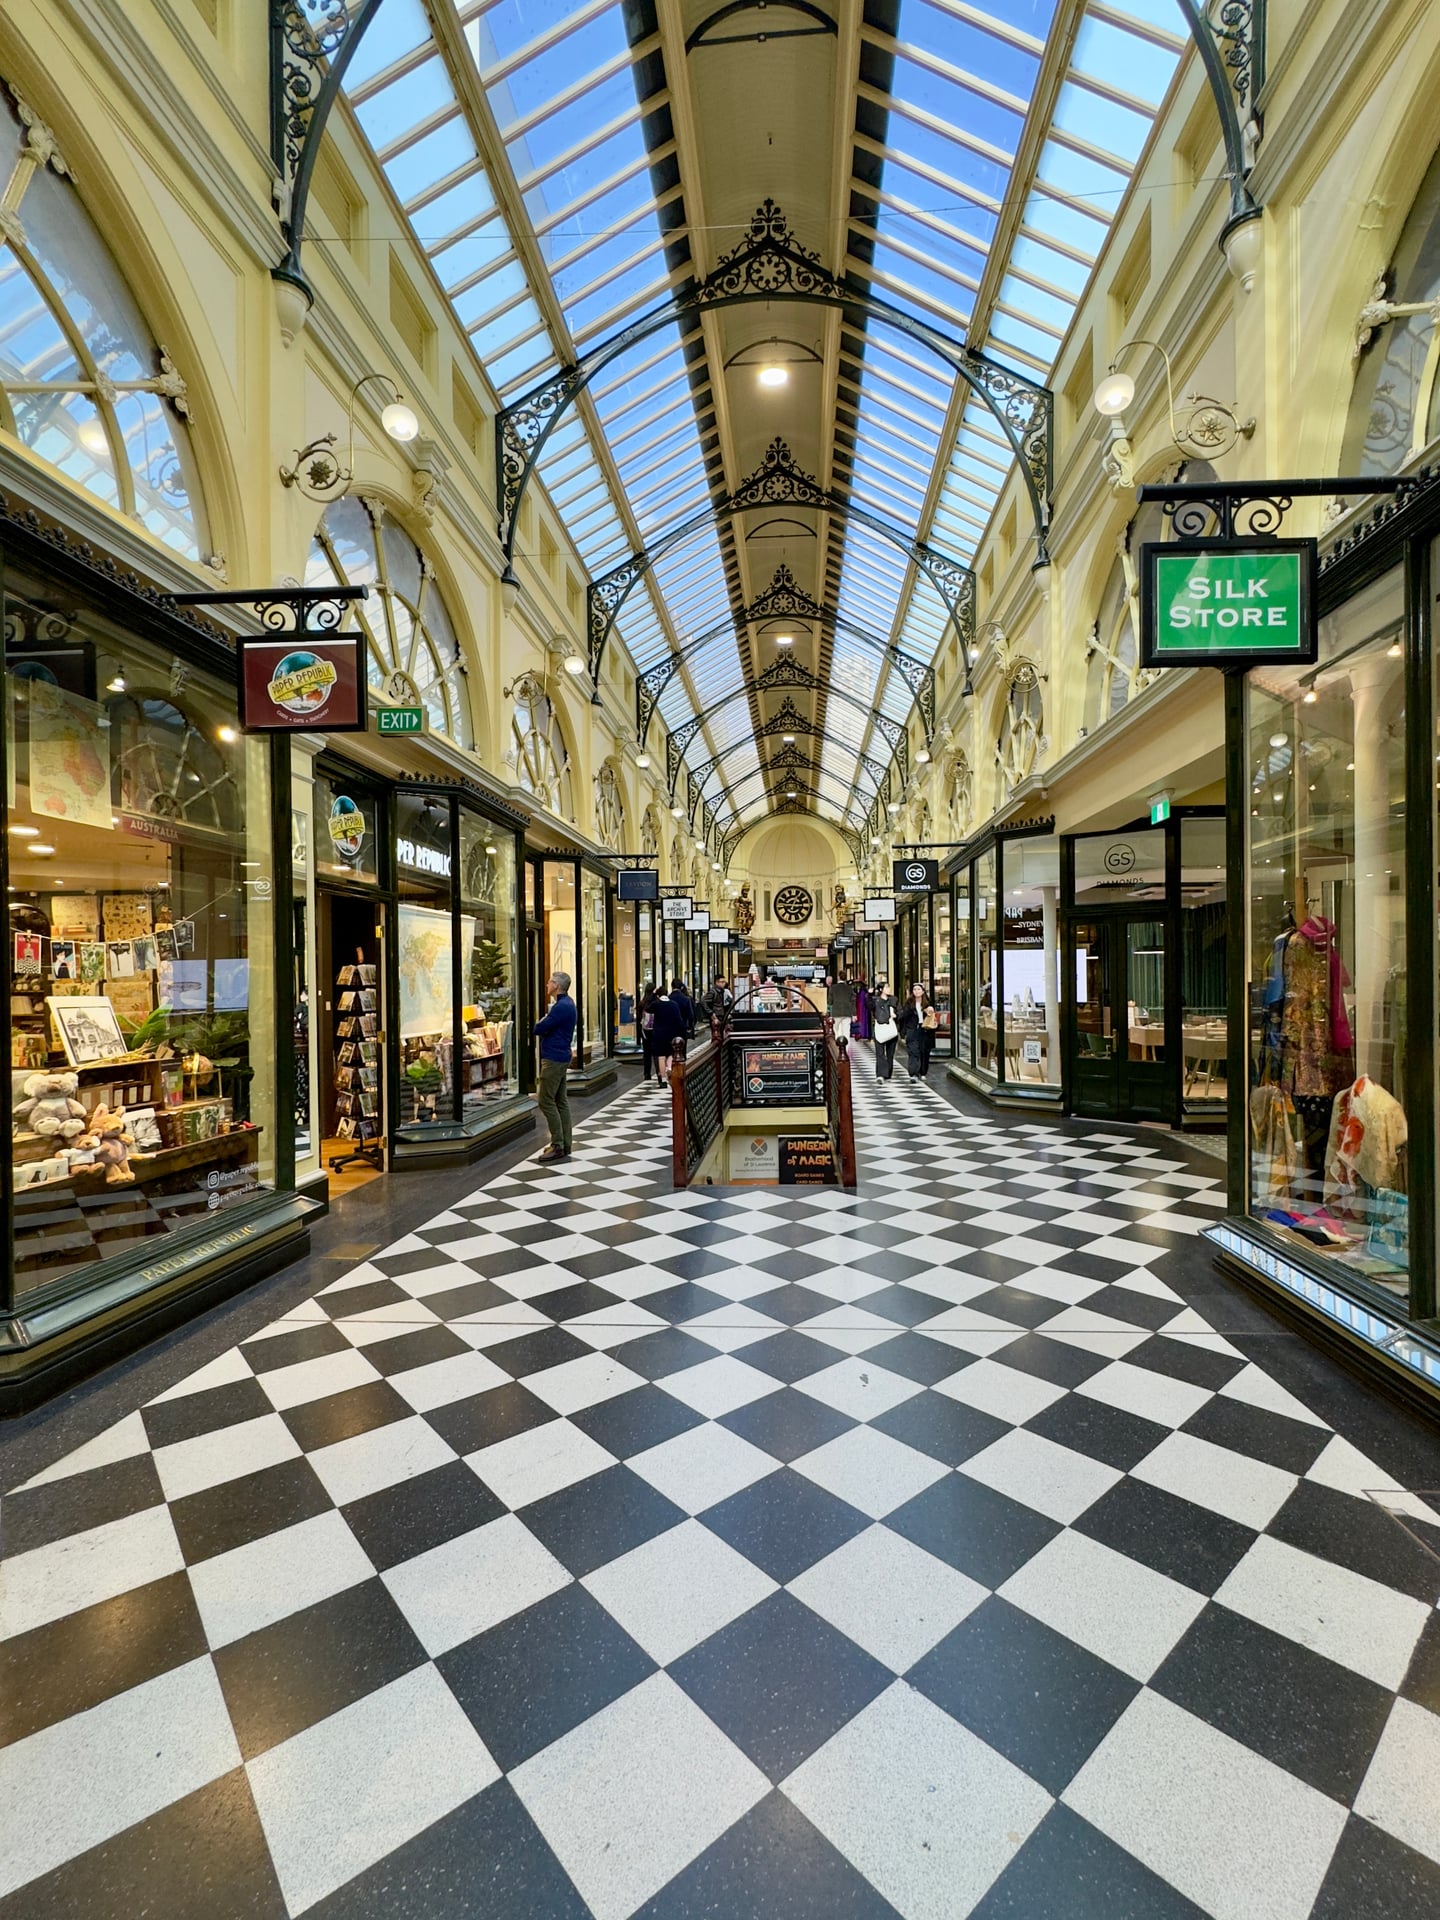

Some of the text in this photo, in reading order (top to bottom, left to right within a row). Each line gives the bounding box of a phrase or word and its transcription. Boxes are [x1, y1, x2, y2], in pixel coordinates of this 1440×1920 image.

[381, 712, 412, 728] EXIT
[130, 819, 178, 839] AUSTRALIA
[1108, 852, 1130, 866] GS
[908, 868, 923, 878] GS
[1016, 936, 1044, 944] BRISBAN
[787, 1140, 833, 1151] DUNGEON
[787, 1155, 832, 1165] of MAGIC
[140, 1225, 257, 1280] PAPER REPUBLIC
